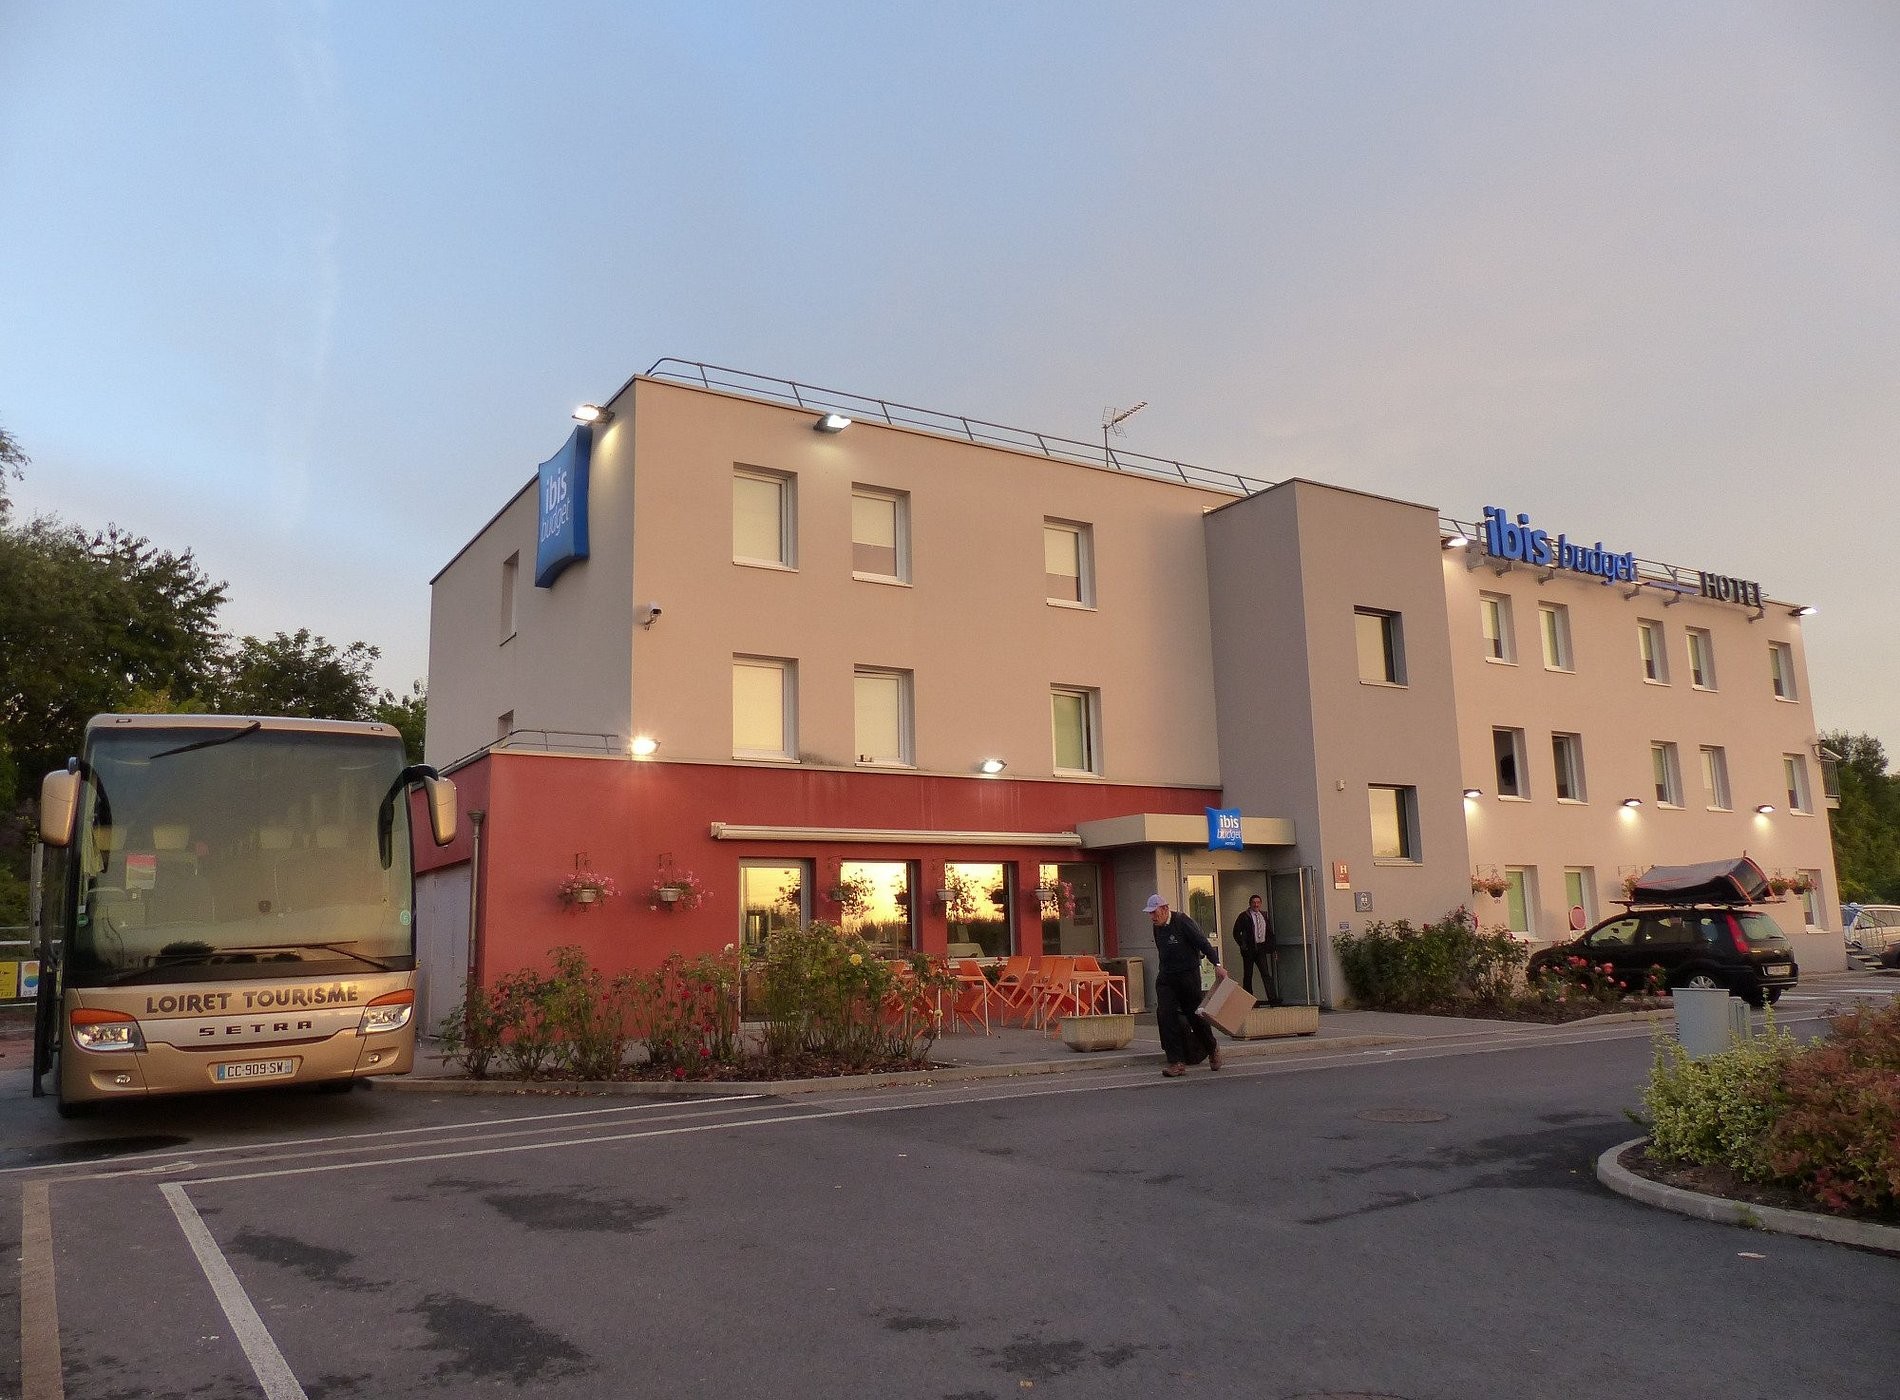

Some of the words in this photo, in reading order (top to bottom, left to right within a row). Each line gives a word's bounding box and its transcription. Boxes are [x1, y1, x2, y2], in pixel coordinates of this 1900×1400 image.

[545, 466, 567, 515] ibis
[541, 498, 571, 543] budget
[1482, 505, 1553, 567] ibis
[1557, 532, 1638, 586] budget
[1700, 571, 1763, 610] HOTEL
[1219, 814, 1240, 829] ibis
[146, 992, 233, 1014] LOIRET
[242, 984, 359, 1009] TOURISME
[199, 1020, 313, 1038] SETRA
